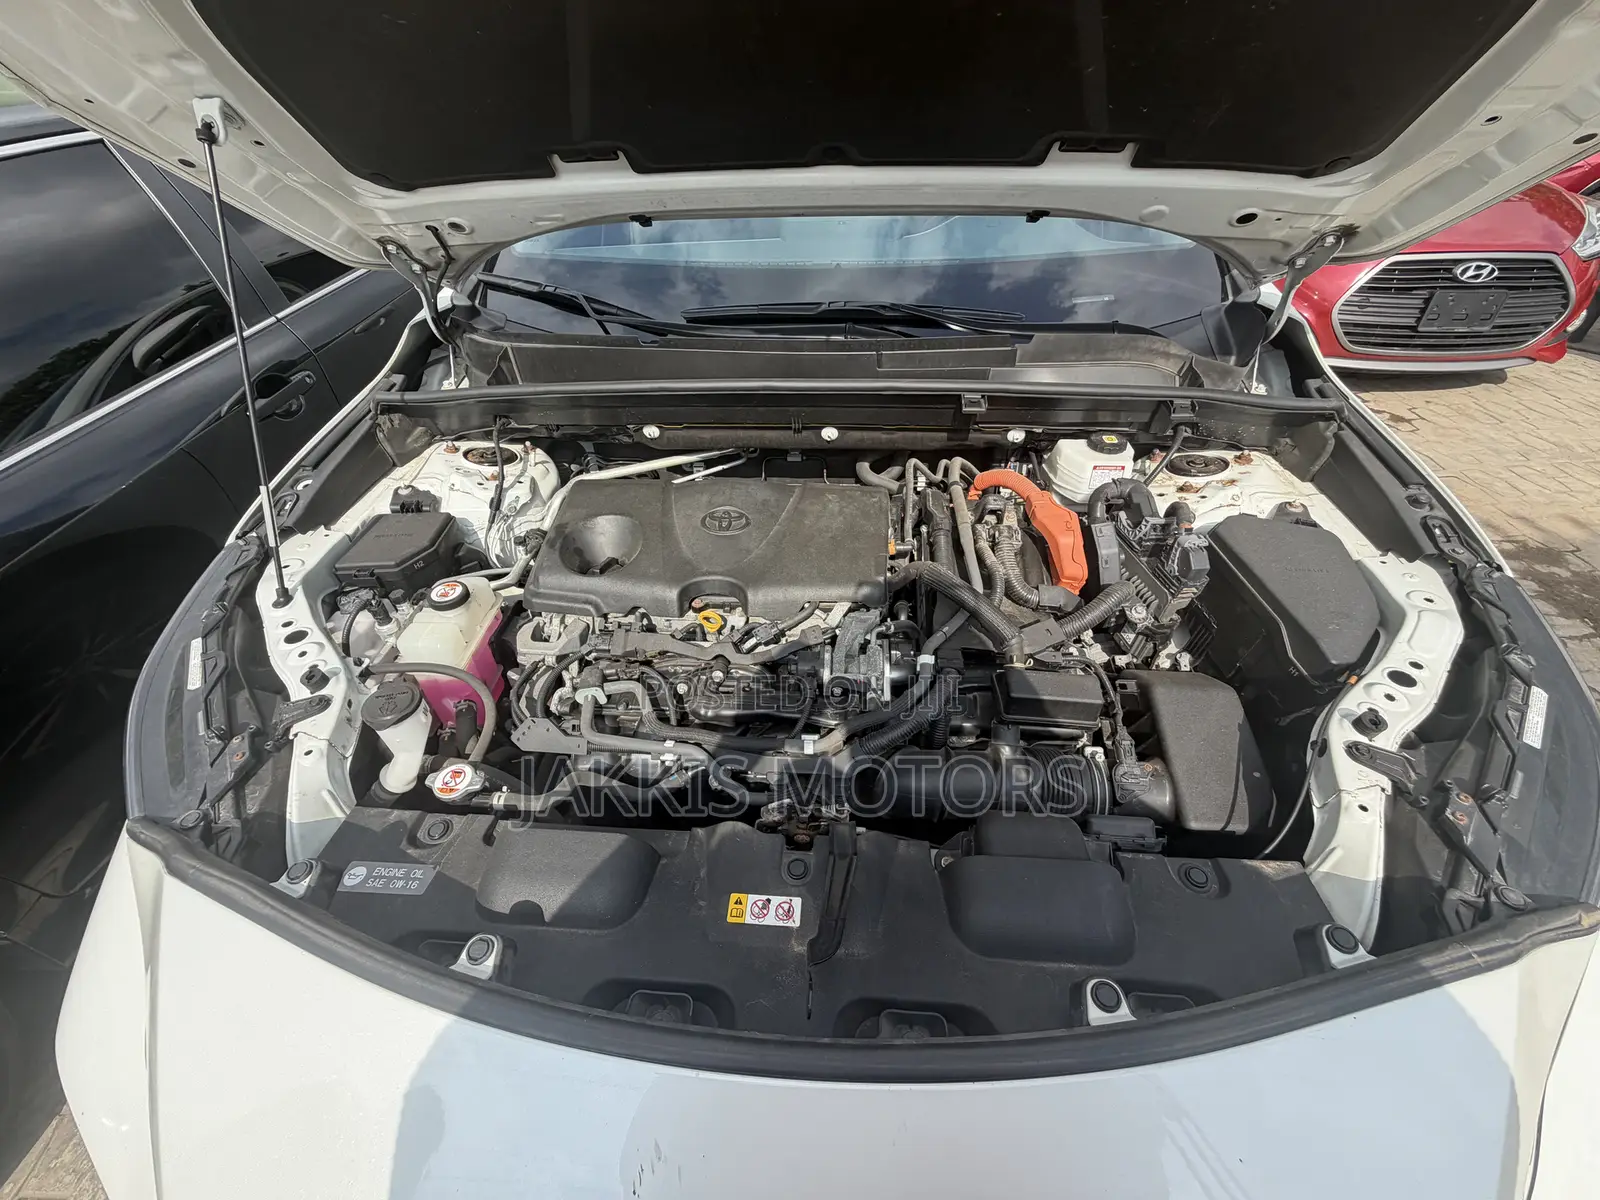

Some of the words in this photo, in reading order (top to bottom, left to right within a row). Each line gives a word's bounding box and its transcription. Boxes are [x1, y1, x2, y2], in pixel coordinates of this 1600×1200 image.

[413, 560, 424, 570] H2
[372, 867, 407, 877] ENGINE
[410, 869, 424, 879] OIL
[365, 878, 387, 888] SAE
[389, 879, 419, 890] 0W-16
